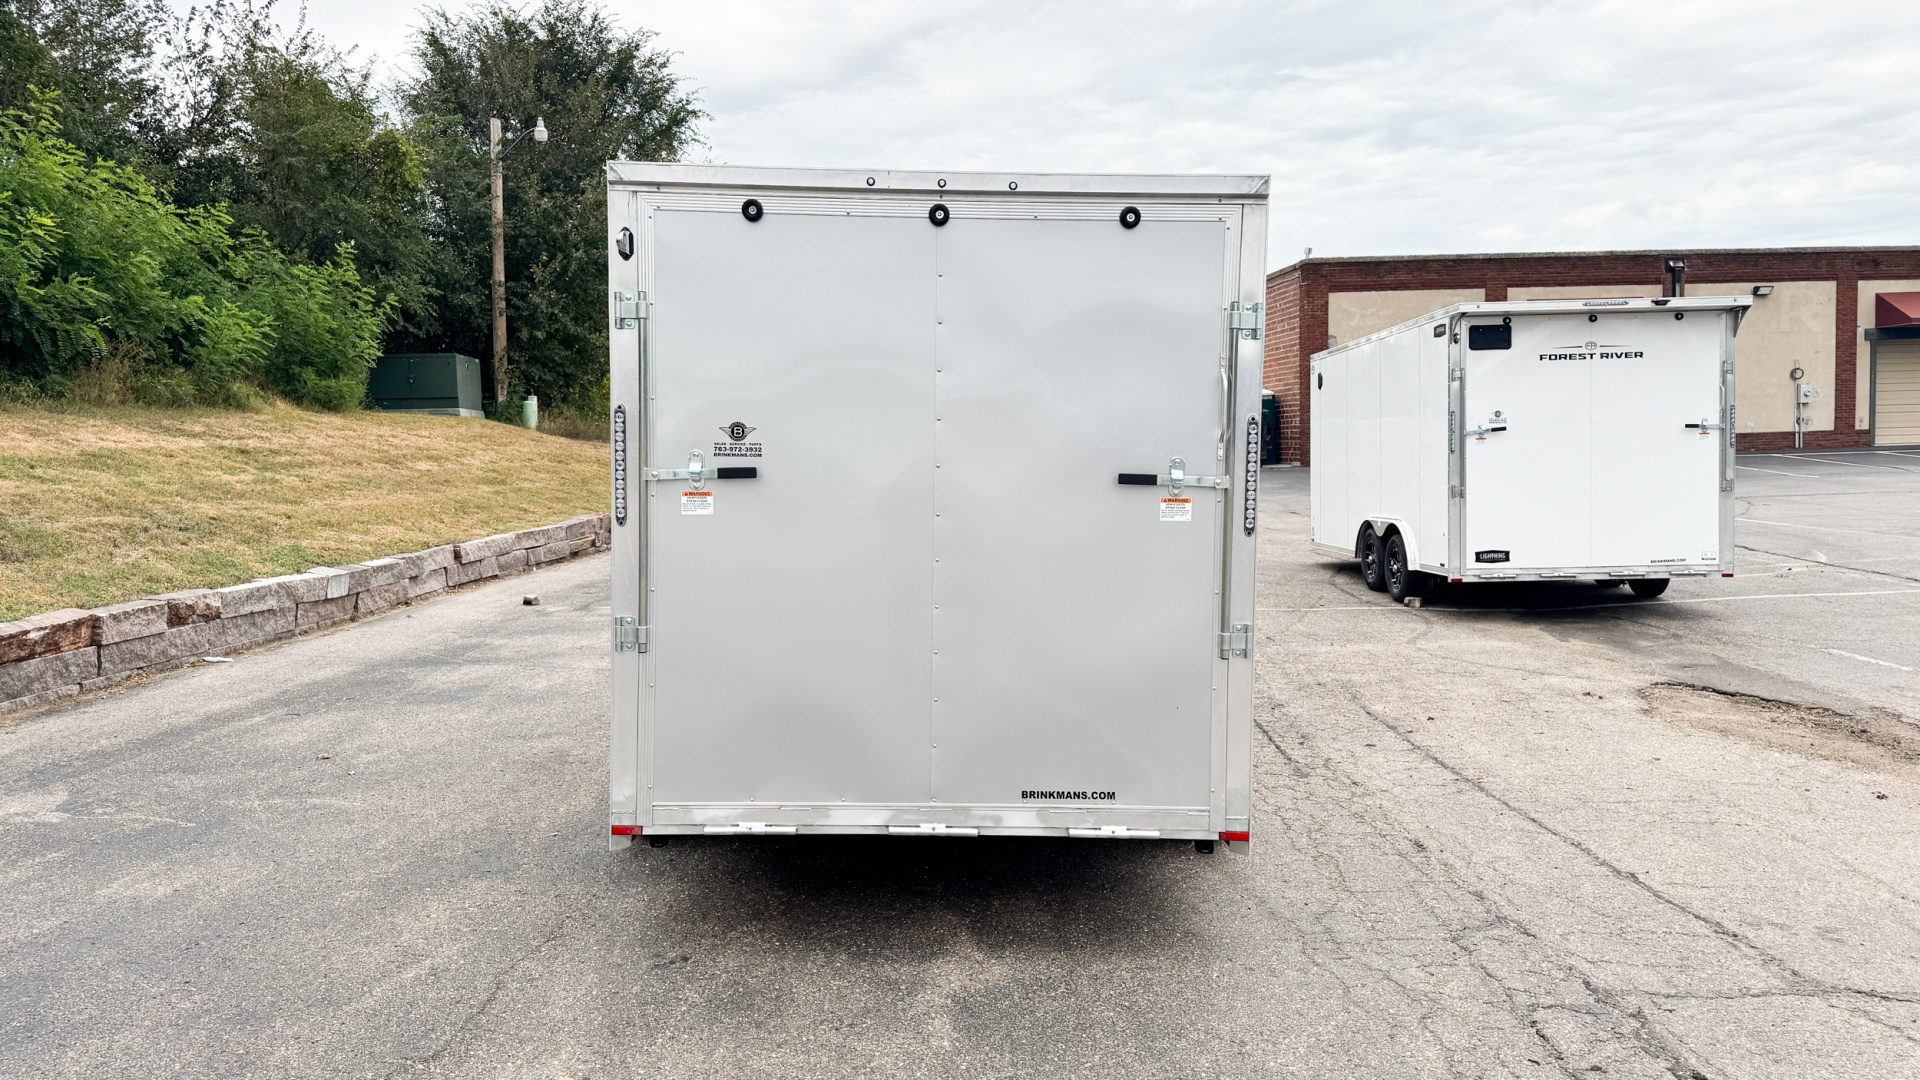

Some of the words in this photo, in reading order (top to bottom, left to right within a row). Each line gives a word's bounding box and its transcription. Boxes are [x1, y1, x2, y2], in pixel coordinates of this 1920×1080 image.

[1539, 353, 1597, 361] FOREST
[1599, 351, 1644, 359] RIVER
[733, 426, 743, 437] B
[1480, 552, 1506, 560] LIGHTNING
[1021, 790, 1116, 800] BRINKMANS.COM
